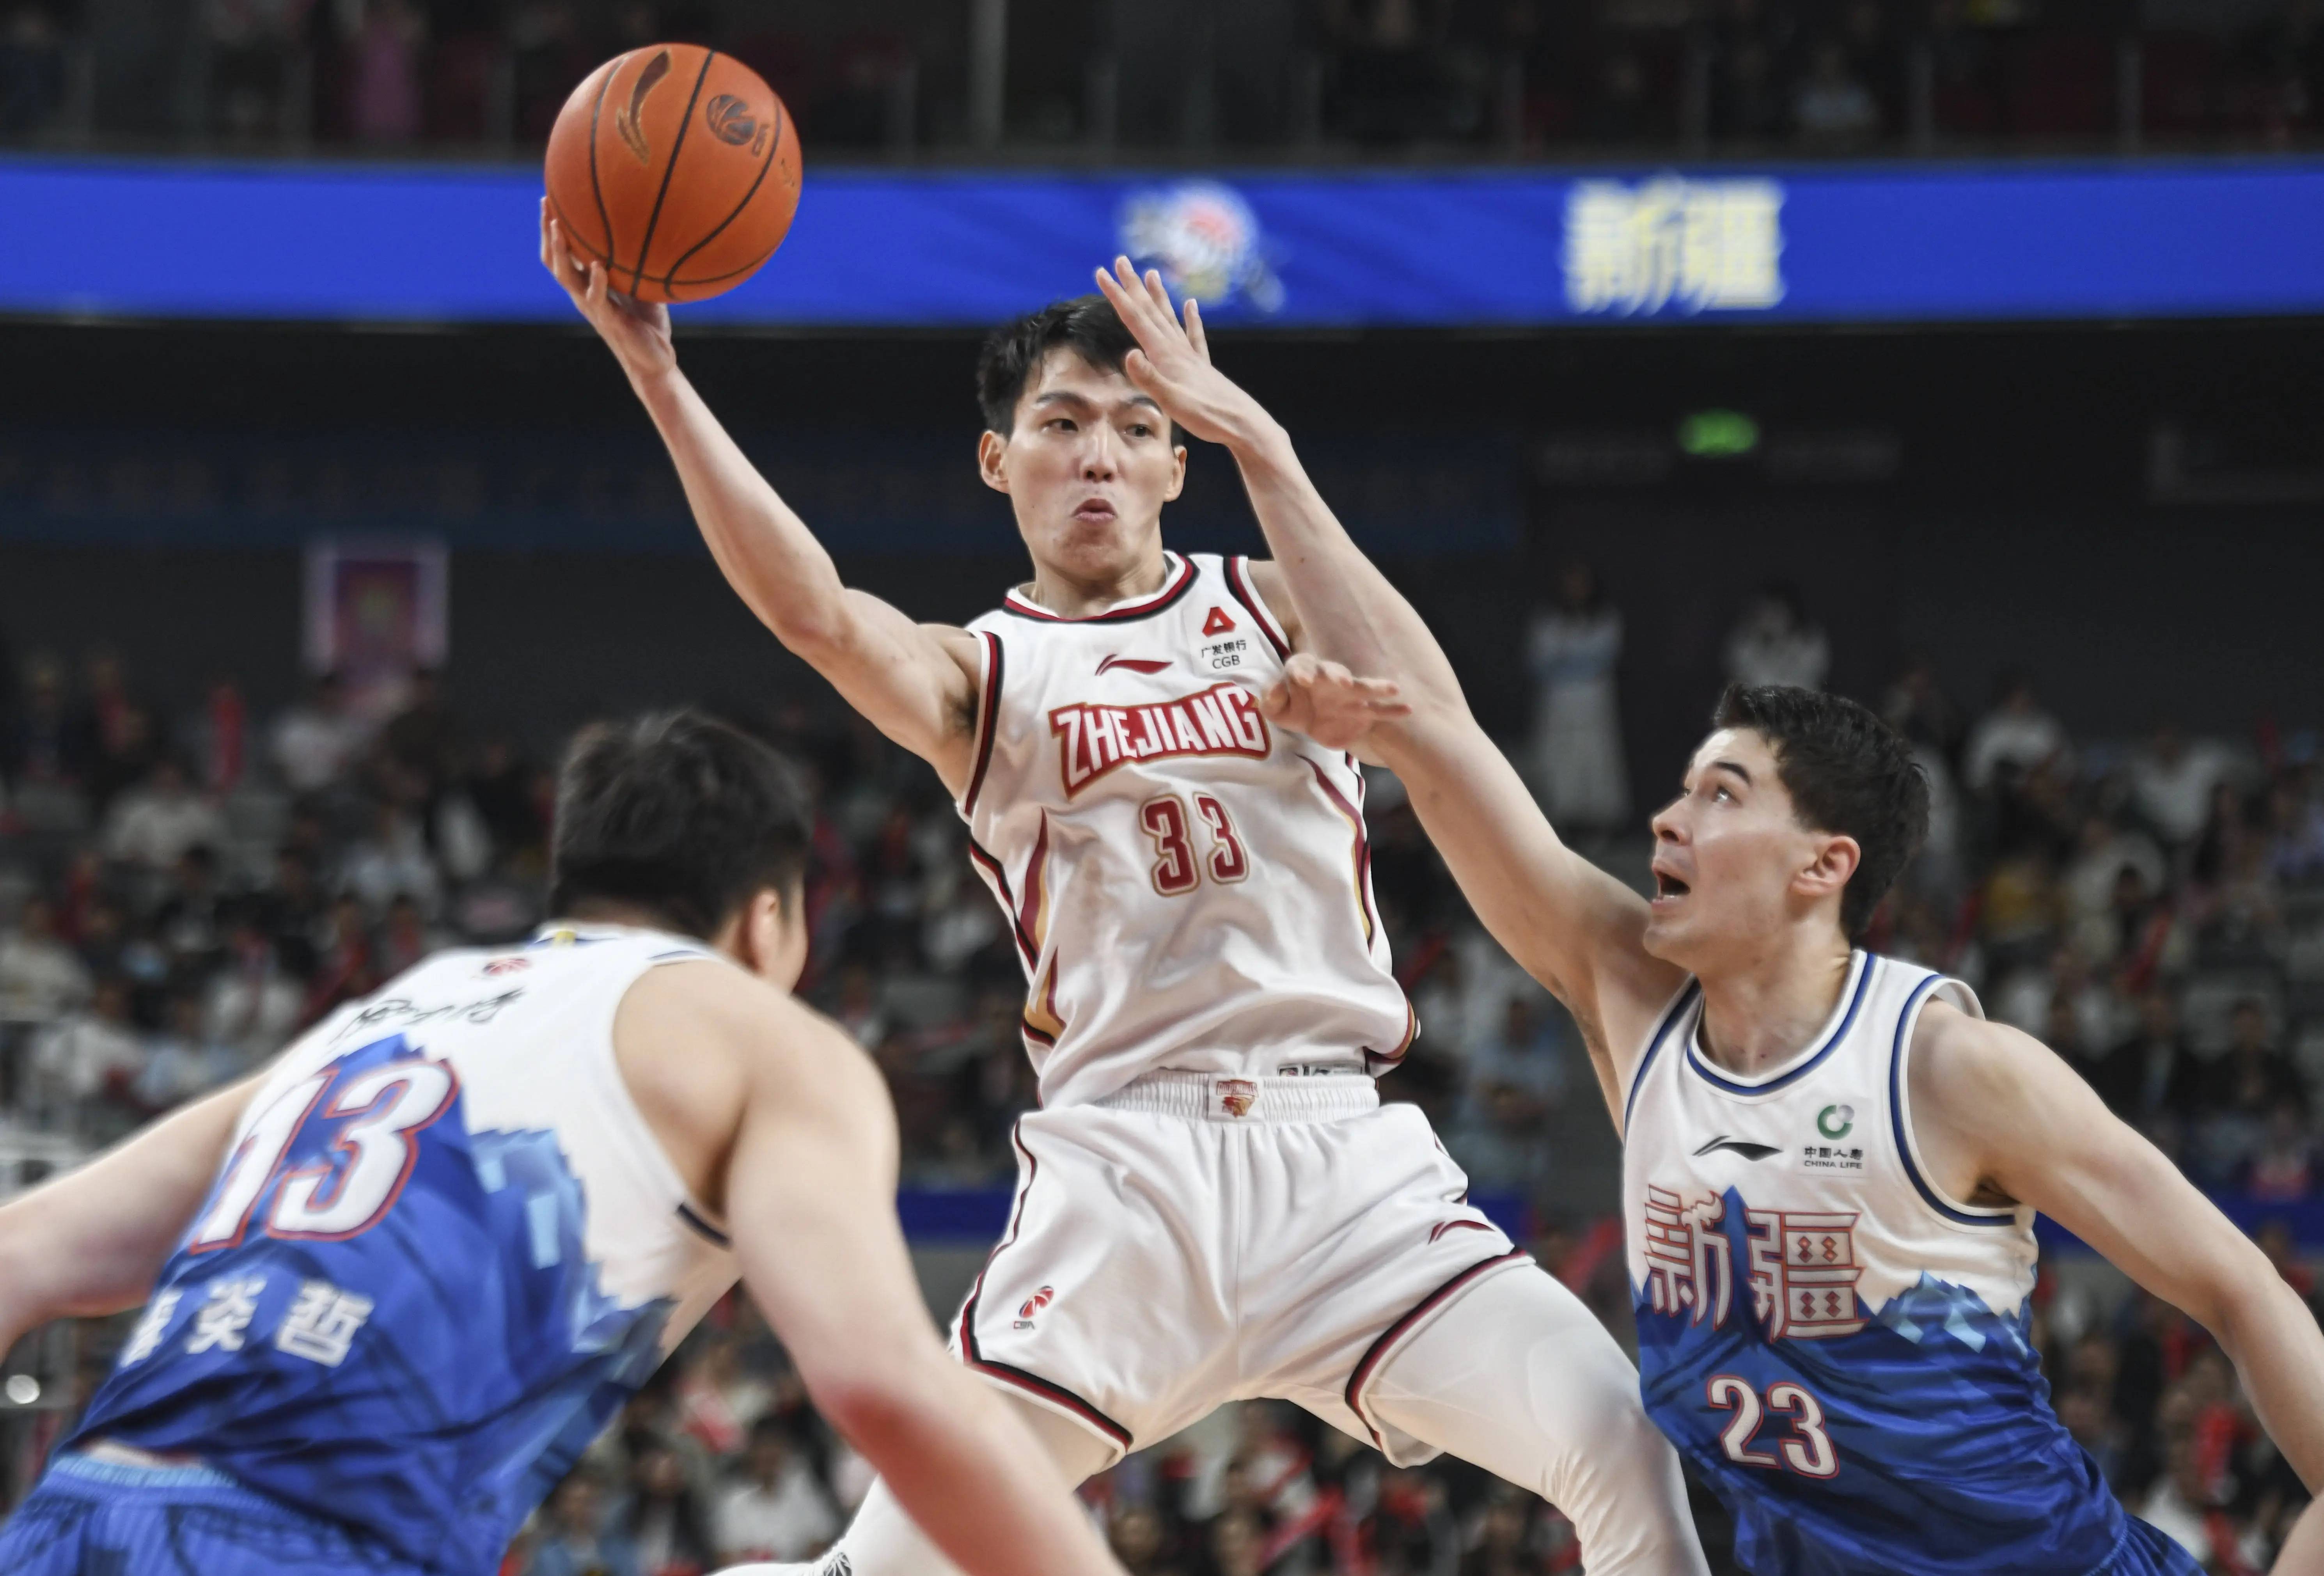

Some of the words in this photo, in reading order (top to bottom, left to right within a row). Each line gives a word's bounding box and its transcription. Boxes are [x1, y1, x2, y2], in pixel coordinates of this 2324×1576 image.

[1201, 640, 1247, 658] 广发银行
[1212, 655, 1241, 669] CGB
[1052, 683, 1269, 793] ZHEJIANG
[1139, 792, 1249, 897] 33
[190, 1056, 461, 1255] 13
[1645, 1184, 1870, 1343] 新疆
[1707, 1375, 1840, 1479] 23
